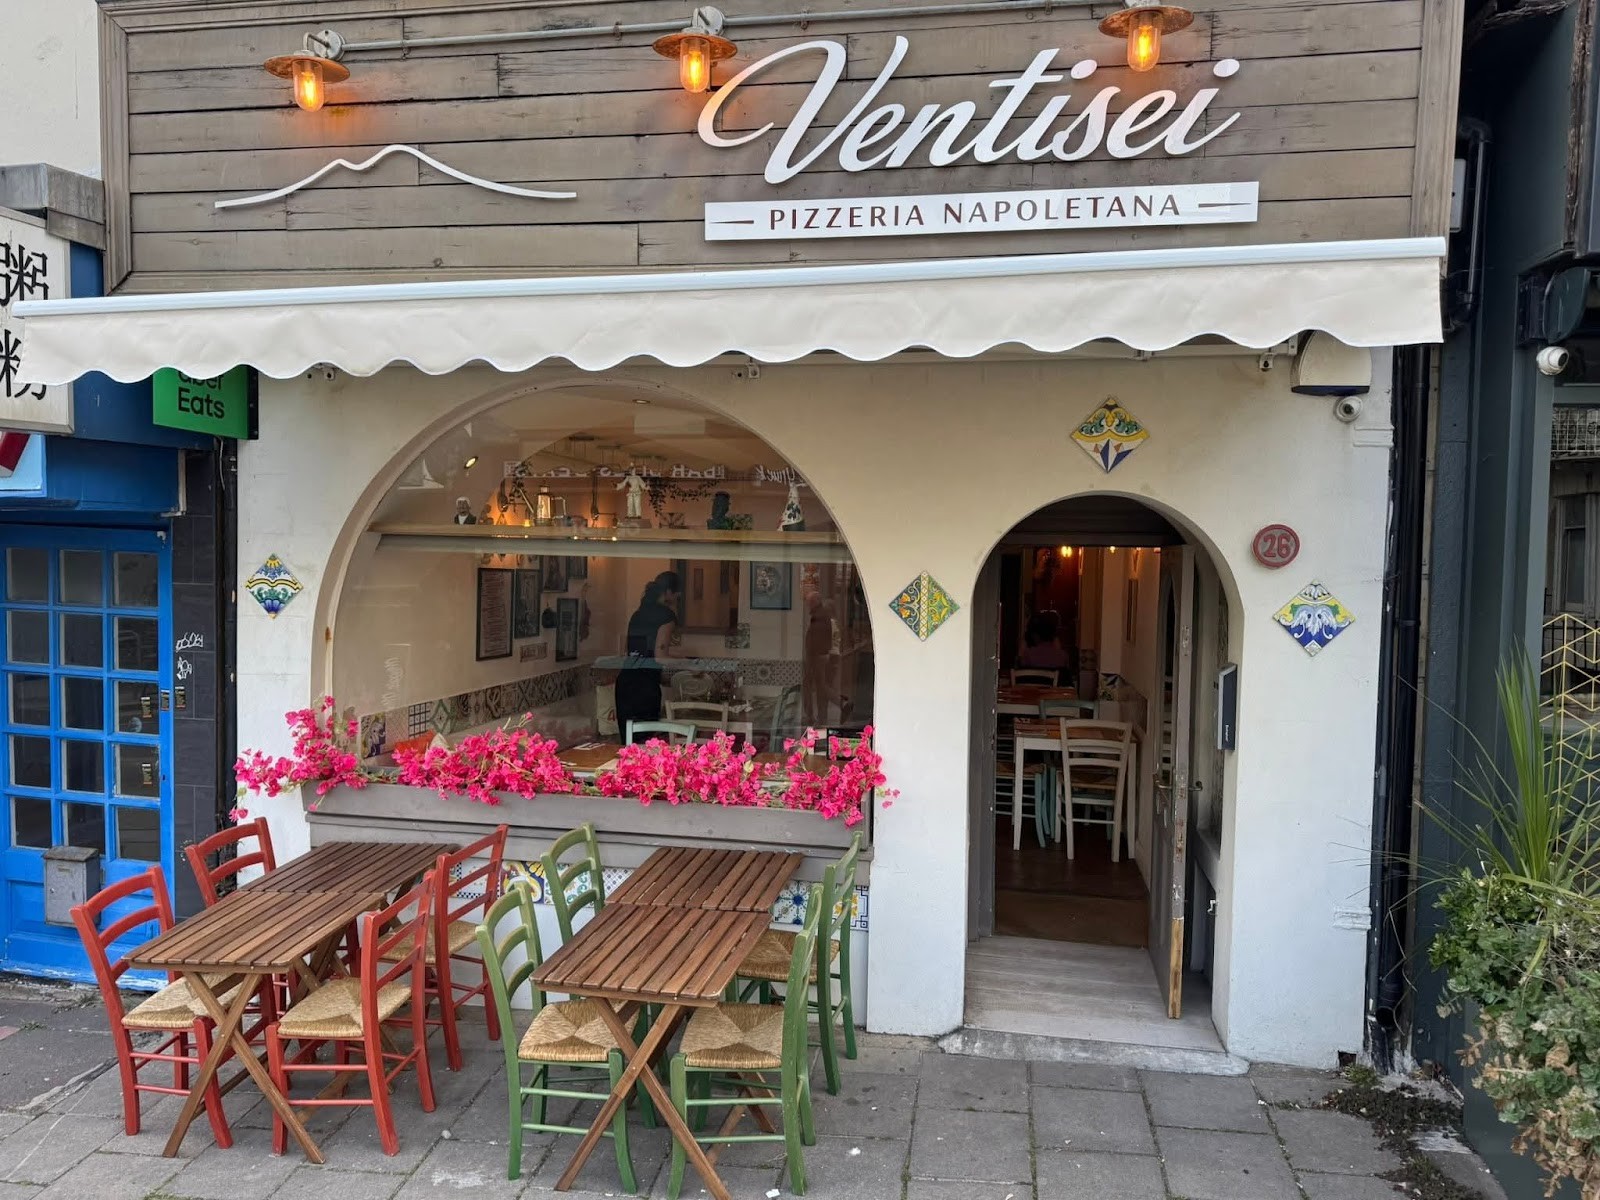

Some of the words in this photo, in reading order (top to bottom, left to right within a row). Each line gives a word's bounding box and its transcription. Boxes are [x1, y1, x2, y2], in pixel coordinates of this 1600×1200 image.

[697, 35, 1241, 184] Ventisei
[769, 206, 924, 231] PIZZERIA
[943, 194, 1181, 223] NAPOLETANA
[177, 387, 225, 420] Eats
[1263, 533, 1291, 559] 26
